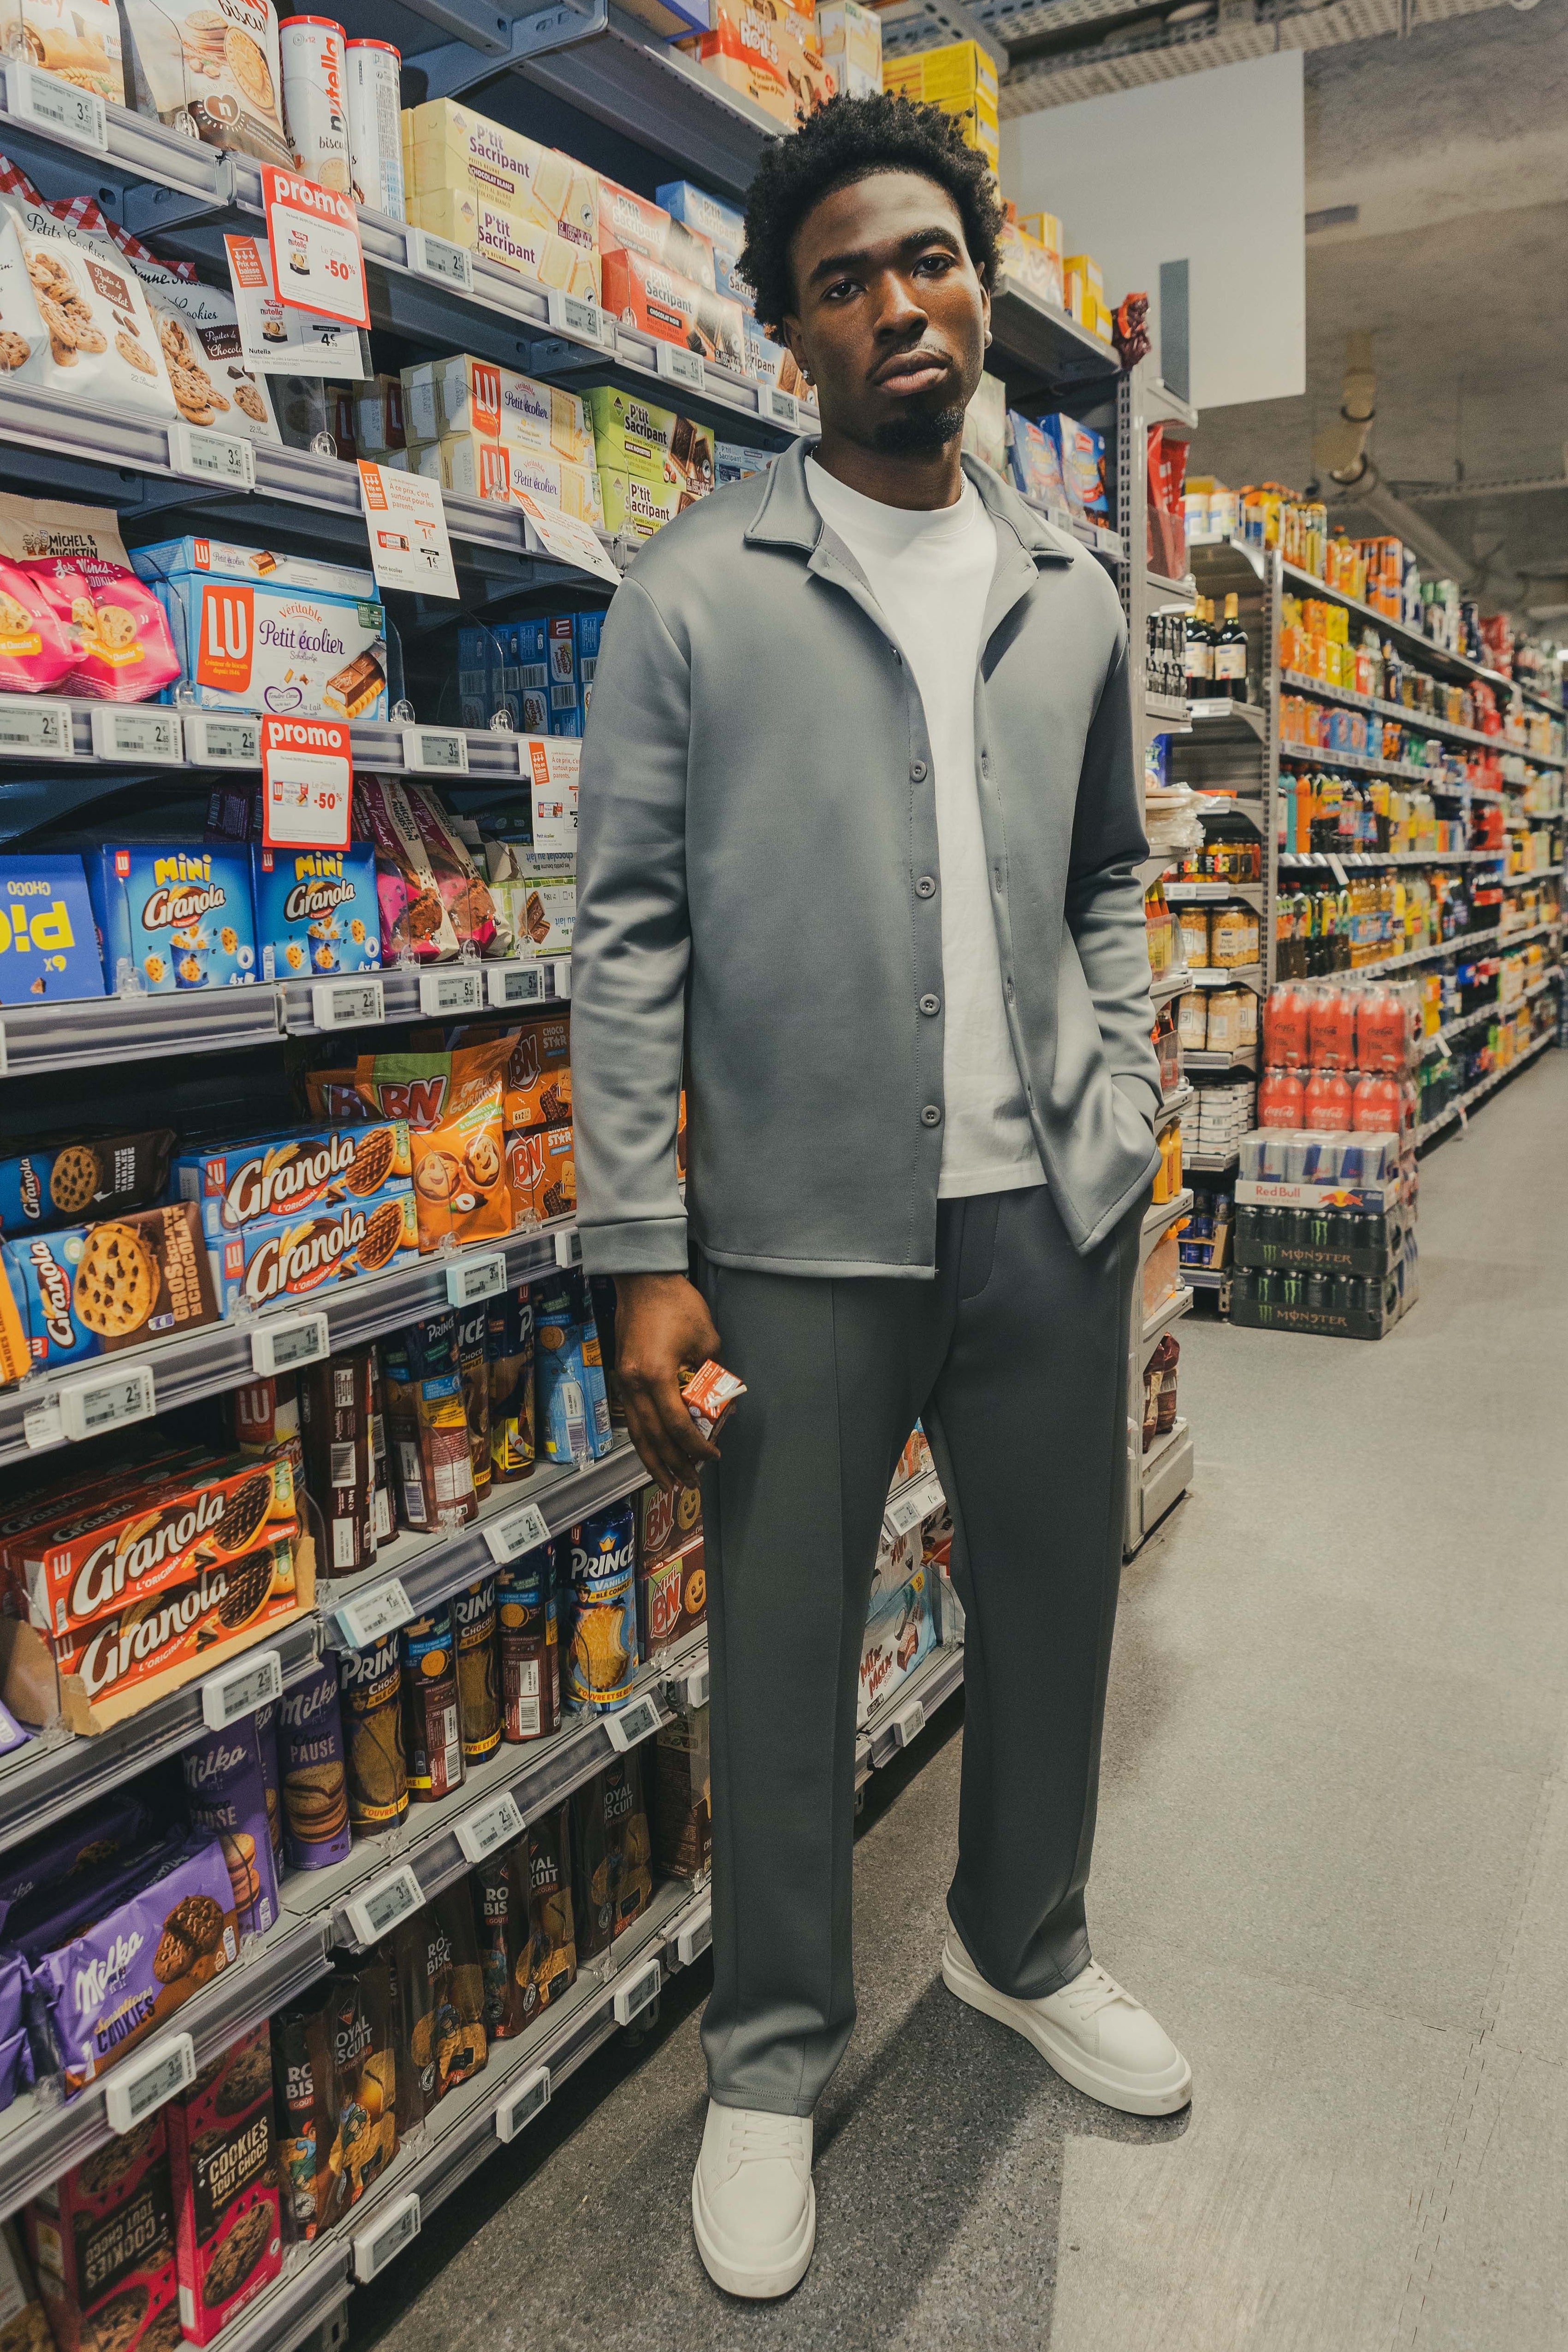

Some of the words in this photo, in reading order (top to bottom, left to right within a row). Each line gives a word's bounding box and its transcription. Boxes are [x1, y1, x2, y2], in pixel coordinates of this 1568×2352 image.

[320, 36, 342, 132] nutella
[218, 102, 231, 118] n
[476, 123, 503, 151] P'tit
[469, 136, 530, 178] Sacripant
[273, 174, 349, 220] promo
[497, 177, 513, 193] BLANC
[27, 213, 63, 240] Petits
[64, 225, 107, 262] Cookies
[485, 211, 510, 237] P'tit
[288, 238, 307, 249] nutella
[478, 225, 535, 264] Sacripant
[239, 266, 260, 274] baisse
[94, 279, 130, 309] Chocolat
[175, 296, 219, 319] Cookies
[646, 280, 692, 313] Sacripant
[260, 308, 283, 316] nutella
[649, 308, 669, 321] CHOCOLAT
[669, 315, 680, 326] NOIR
[205, 329, 229, 343] Pépites
[229, 330, 237, 339] de
[249, 347, 271, 355] Nutella
[474, 369, 497, 414] LU
[514, 382, 536, 397] Véritable
[504, 390, 524, 412] Petit
[524, 400, 549, 419] écolier
[629, 403, 650, 424] P'tit
[624, 415, 668, 445] Sacripant
[625, 442, 633, 450] AUX
[633, 444, 651, 458] NOISETTES
[718, 452, 742, 462] Sacripant
[721, 445, 732, 454] P'tit
[523, 459, 546, 473] Véritable
[416, 490, 430, 498] c'est
[514, 469, 533, 486] Petit
[533, 478, 558, 496] écolier
[631, 483, 651, 502] P'tit
[390, 492, 411, 503] surtout
[412, 497, 426, 507] pour
[426, 499, 434, 508] les
[392, 500, 415, 512] parents.
[89, 535, 96, 546] &
[195, 543, 208, 564] LU
[76, 558, 113, 574] Minis
[213, 553, 226, 566] Petit
[226, 555, 245, 567] écolier
[278, 601, 323, 623] Véritable
[207, 596, 248, 659] LU
[259, 619, 297, 649] Petit
[298, 627, 346, 656] écolier
[556, 620, 570, 636] LU
[309, 702, 322, 711] Lait
[268, 721, 342, 748] promo
[117, 856, 128, 871] LU
[264, 854, 273, 867] LU
[7, 881, 51, 897] CHOCO
[284, 879, 356, 920] Granola
[143, 883, 226, 928] Granola
[555, 917, 566, 928] lait
[542, 1025, 564, 1036] CHOCO
[510, 1034, 538, 1086] BN
[379, 1075, 447, 1121] BN
[512, 1133, 542, 1186] BN
[207, 1161, 224, 1186] LU
[224, 1135, 356, 1223] Granola
[20, 1157, 41, 1220] Granola
[277, 1189, 318, 1213] L'ORIGINAL
[1255, 1185, 1278, 1196] Red
[1279, 1187, 1301, 1198] Bull
[172, 1206, 202, 1306] CHOCOLAT
[227, 1242, 242, 1269] LU
[244, 1210, 367, 1300] Granola
[1280, 1248, 1353, 1265] MONSTER
[164, 1259, 190, 1322] GROS
[293, 1266, 332, 1291] L'ORIGINAL
[30, 1240, 76, 1349] Granola
[427, 1315, 455, 1343] PRINCE
[1276, 1309, 1349, 1327] MONSTER
[33, 1338, 43, 1357] LU
[239, 1388, 270, 1424] LU
[51, 1502, 136, 1543] Granola
[645, 1494, 673, 1547] BN
[572, 1529, 580, 1541] LU
[53, 1553, 71, 1581] LU
[72, 1492, 227, 1616] Granola
[571, 1541, 634, 1580] PRINCE
[136, 1556, 182, 1591] L'ORIGINAL
[594, 1572, 630, 1590] VANILLE
[916, 1576, 922, 1587] 10
[596, 1590, 608, 1600] BLÉ
[651, 1576, 681, 1637] BN
[80, 1568, 230, 1698] Granola
[55, 1635, 75, 1662] LU
[138, 1635, 187, 1672] L'ORIGINAL
[860, 1644, 883, 1688] Mix
[868, 1650, 893, 1699] Max
[276, 1678, 339, 1726] Milka
[290, 1736, 336, 1763] PAUSE
[482, 1741, 491, 1750] ET
[490, 1737, 497, 1748] SE
[183, 1744, 248, 1789] Milka
[75, 1931, 144, 2015] Milka
[93, 1984, 154, 2034] Sensations
[97, 1994, 156, 2054] COOKIES
[209, 2115, 268, 2186] COOKIES
[211, 2172, 237, 2199] TOUT
[237, 2138, 268, 2186] CHOCO
[85, 2216, 156, 2290] COOKIES
